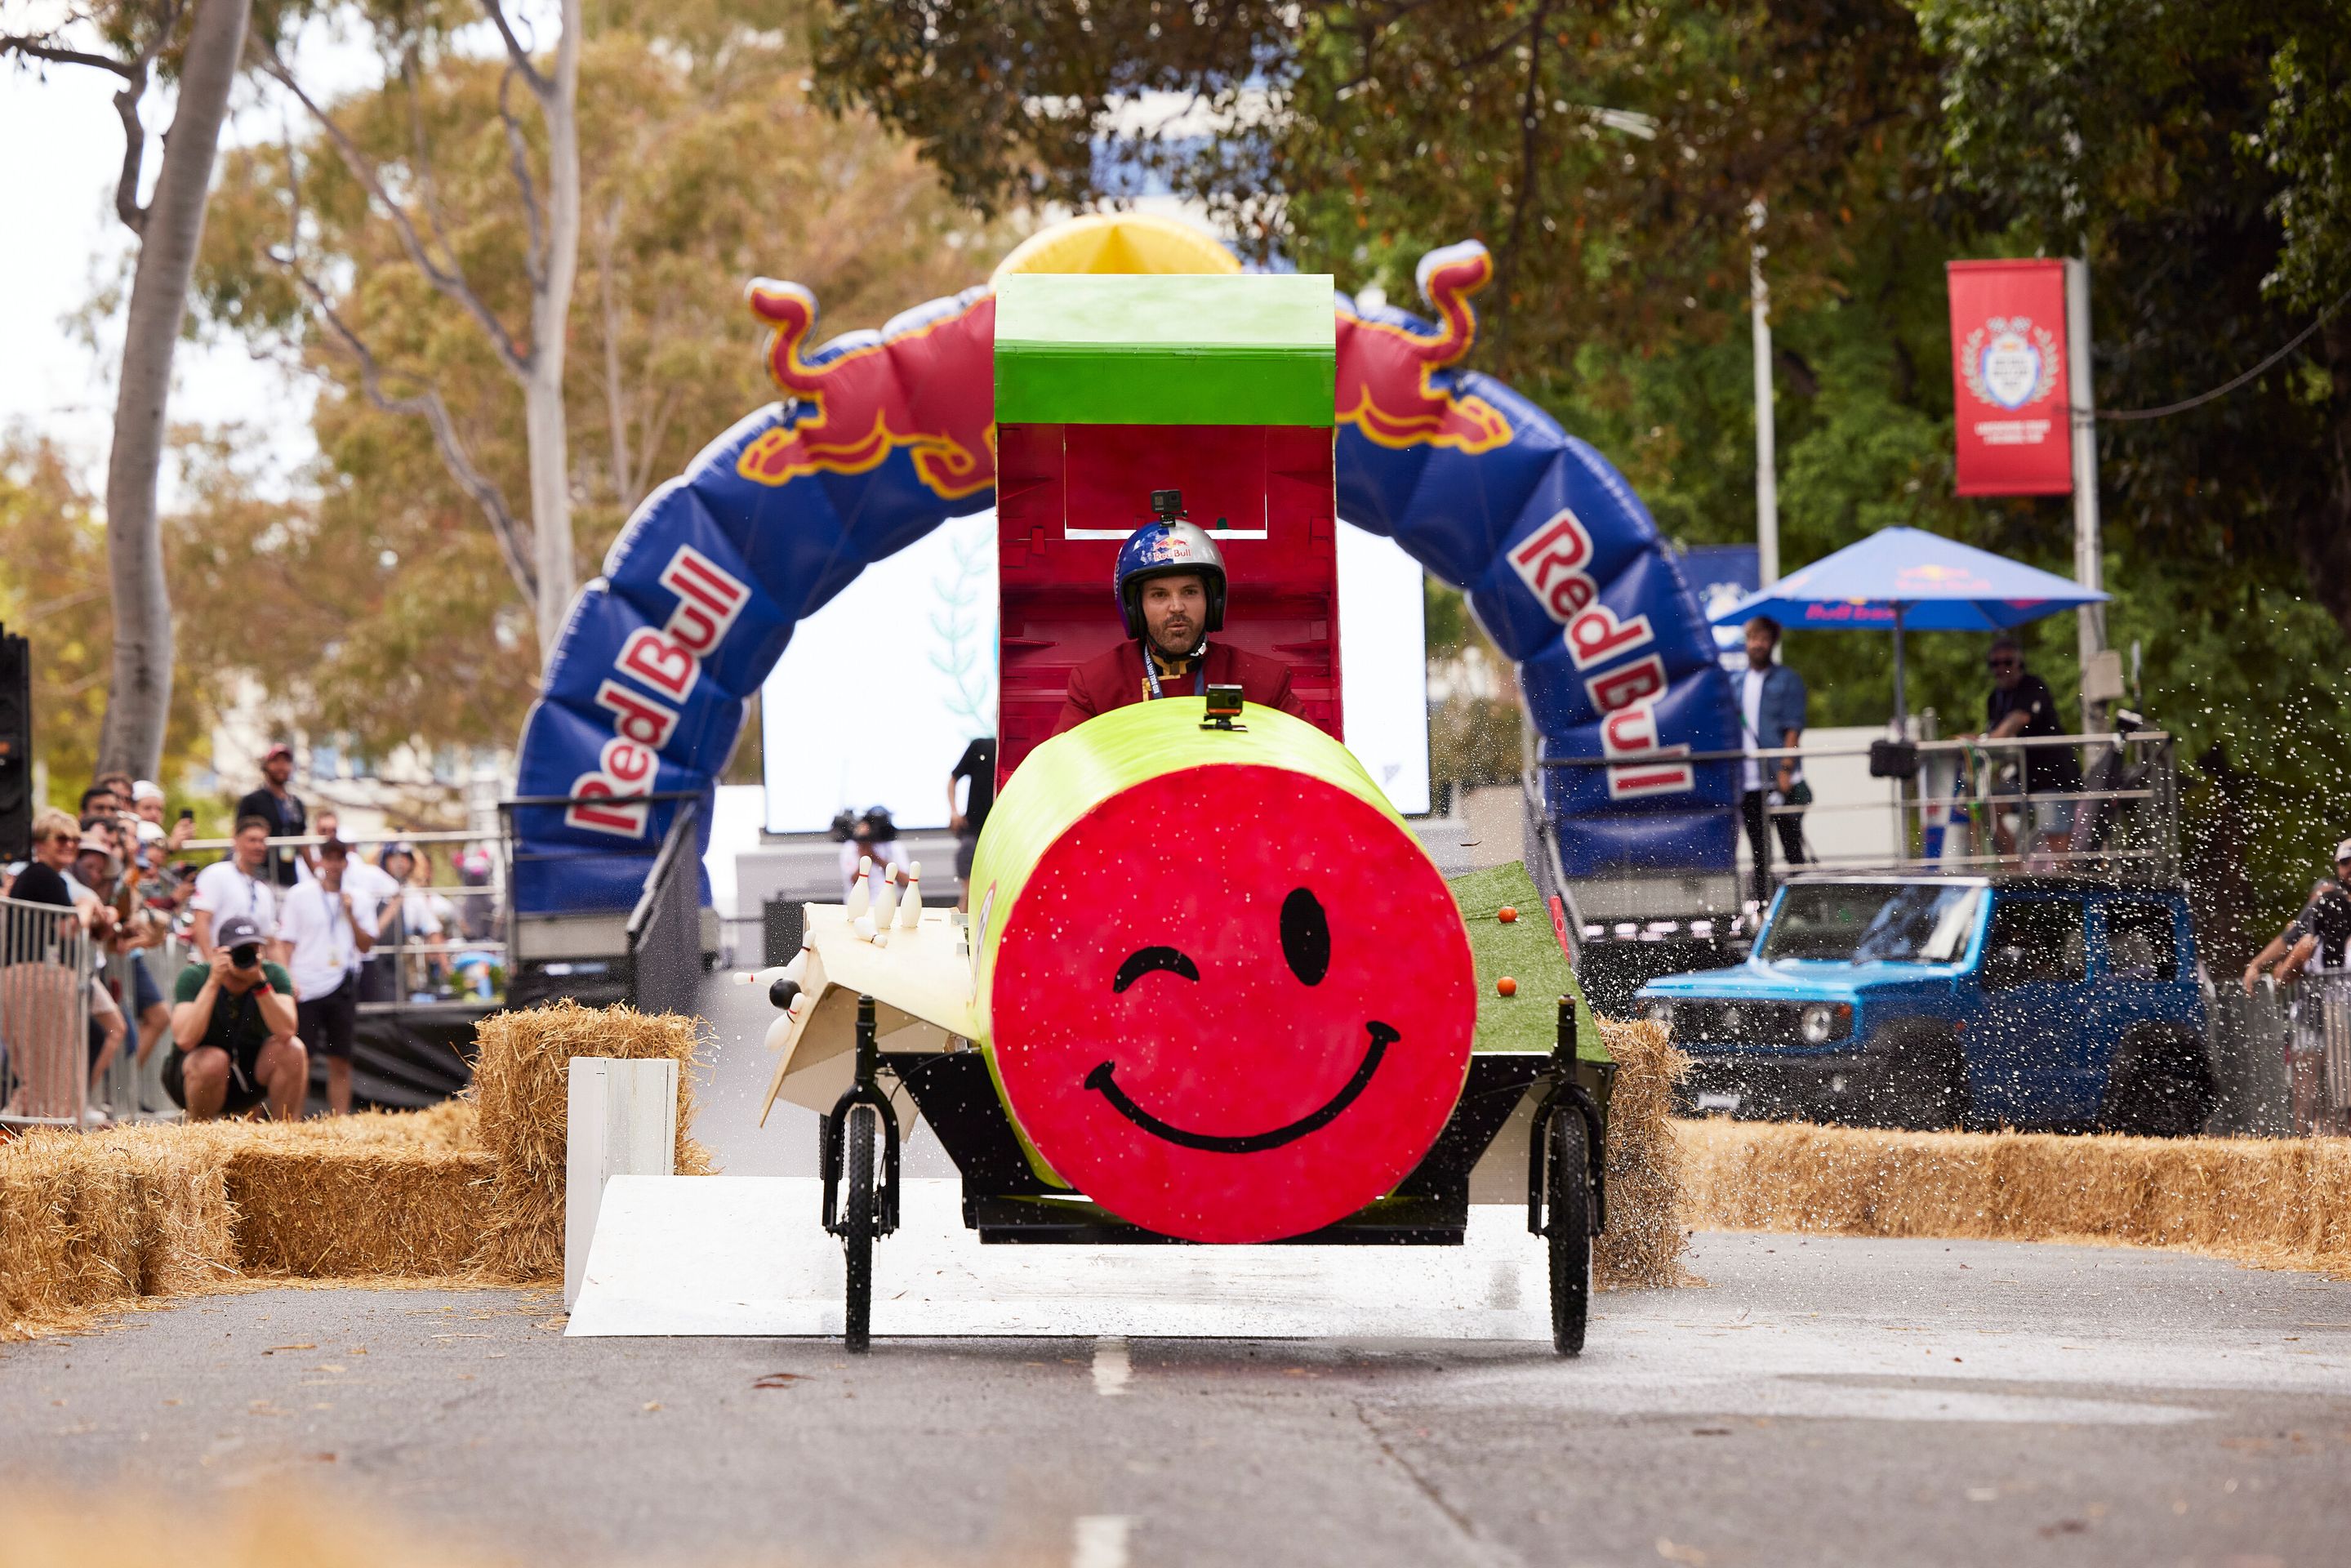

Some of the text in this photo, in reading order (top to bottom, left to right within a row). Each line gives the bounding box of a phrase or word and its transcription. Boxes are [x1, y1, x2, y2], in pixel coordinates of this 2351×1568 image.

[1173, 548, 1191, 557] Bull
[1510, 512, 1650, 666] Red
[568, 548, 747, 835] Red Bull
